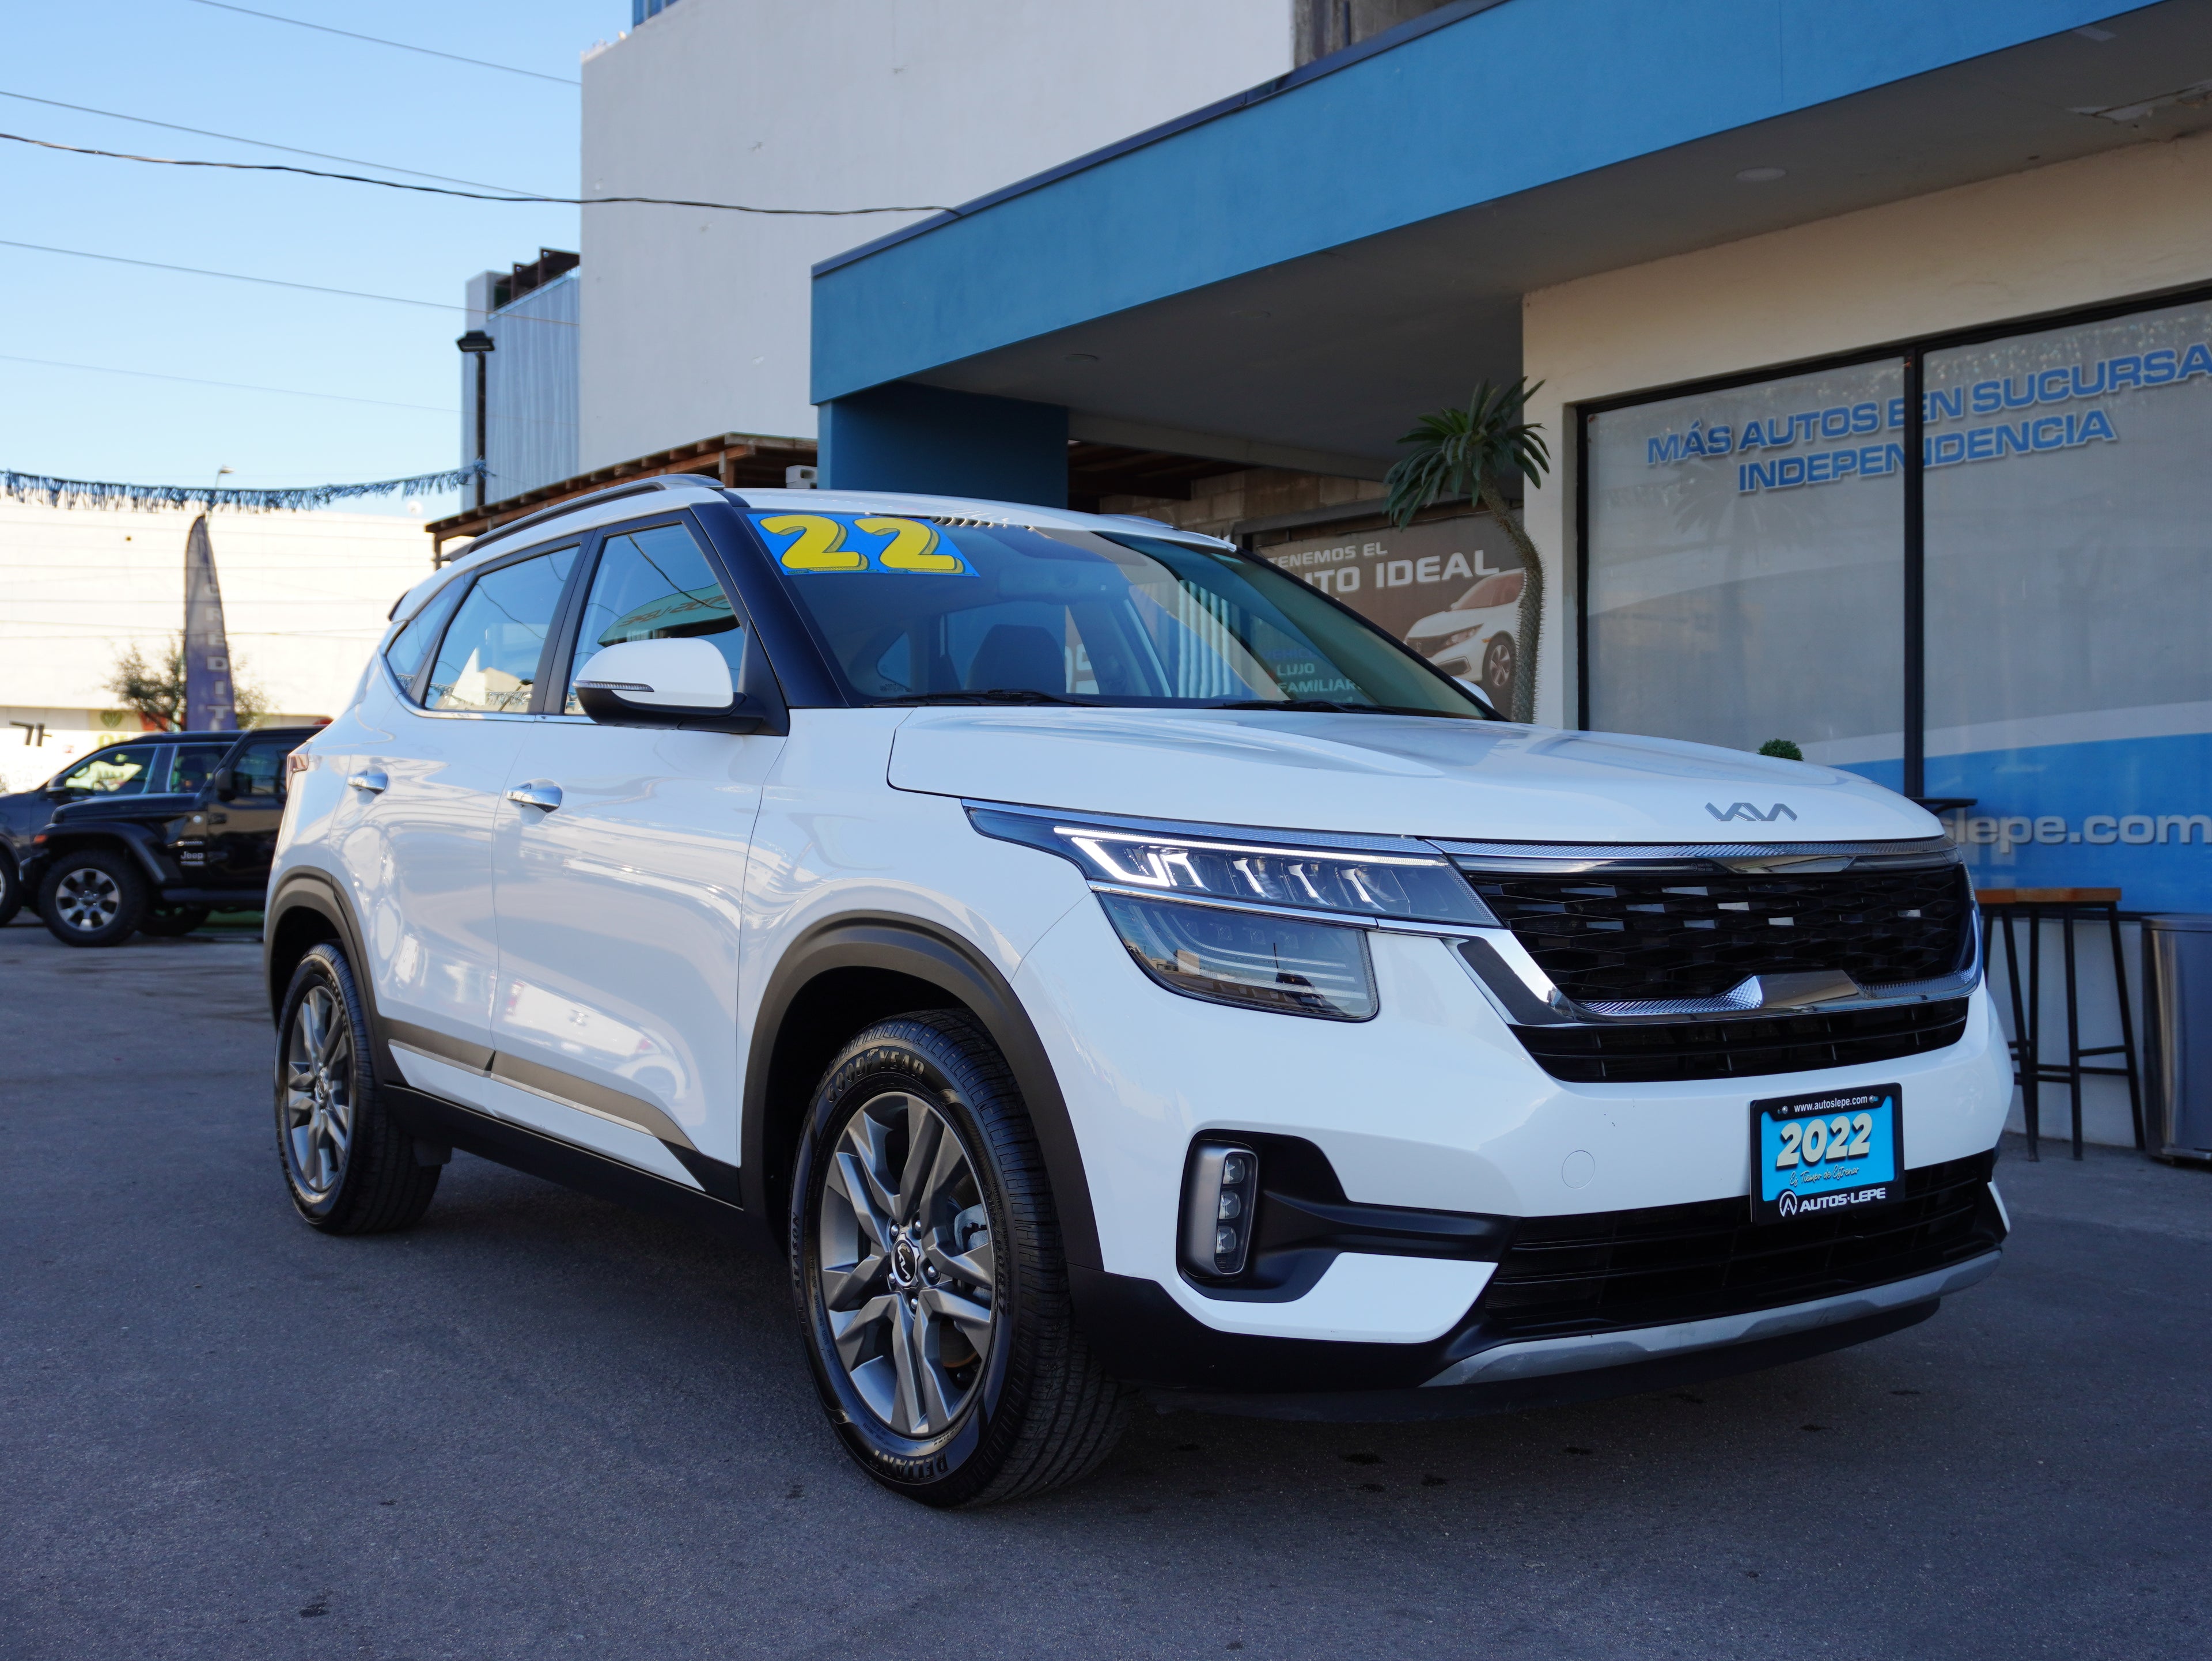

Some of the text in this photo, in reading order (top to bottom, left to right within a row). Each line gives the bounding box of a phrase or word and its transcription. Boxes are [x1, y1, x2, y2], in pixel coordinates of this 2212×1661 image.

[1647, 342, 2212, 465] MÁS AUTOS EN SUCURSA
[1738, 407, 2119, 493] INDEPENDENCIA
[759, 514, 965, 574] 22
[1268, 542, 1388, 569] TENEMOS EL
[1304, 550, 1500, 594] TO IDEAL
[1276, 663, 1316, 676] LUJO
[1278, 678, 1362, 693] FAMILIAR
[1705, 802, 1798, 822] KIA
[180, 851, 204, 860] Jeep
[1794, 1095, 1868, 1113] www.autoslepe.com
[1775, 1112, 1873, 1168] 2022
[1789, 1164, 1860, 1186] Es Tiempo de Estrenar
